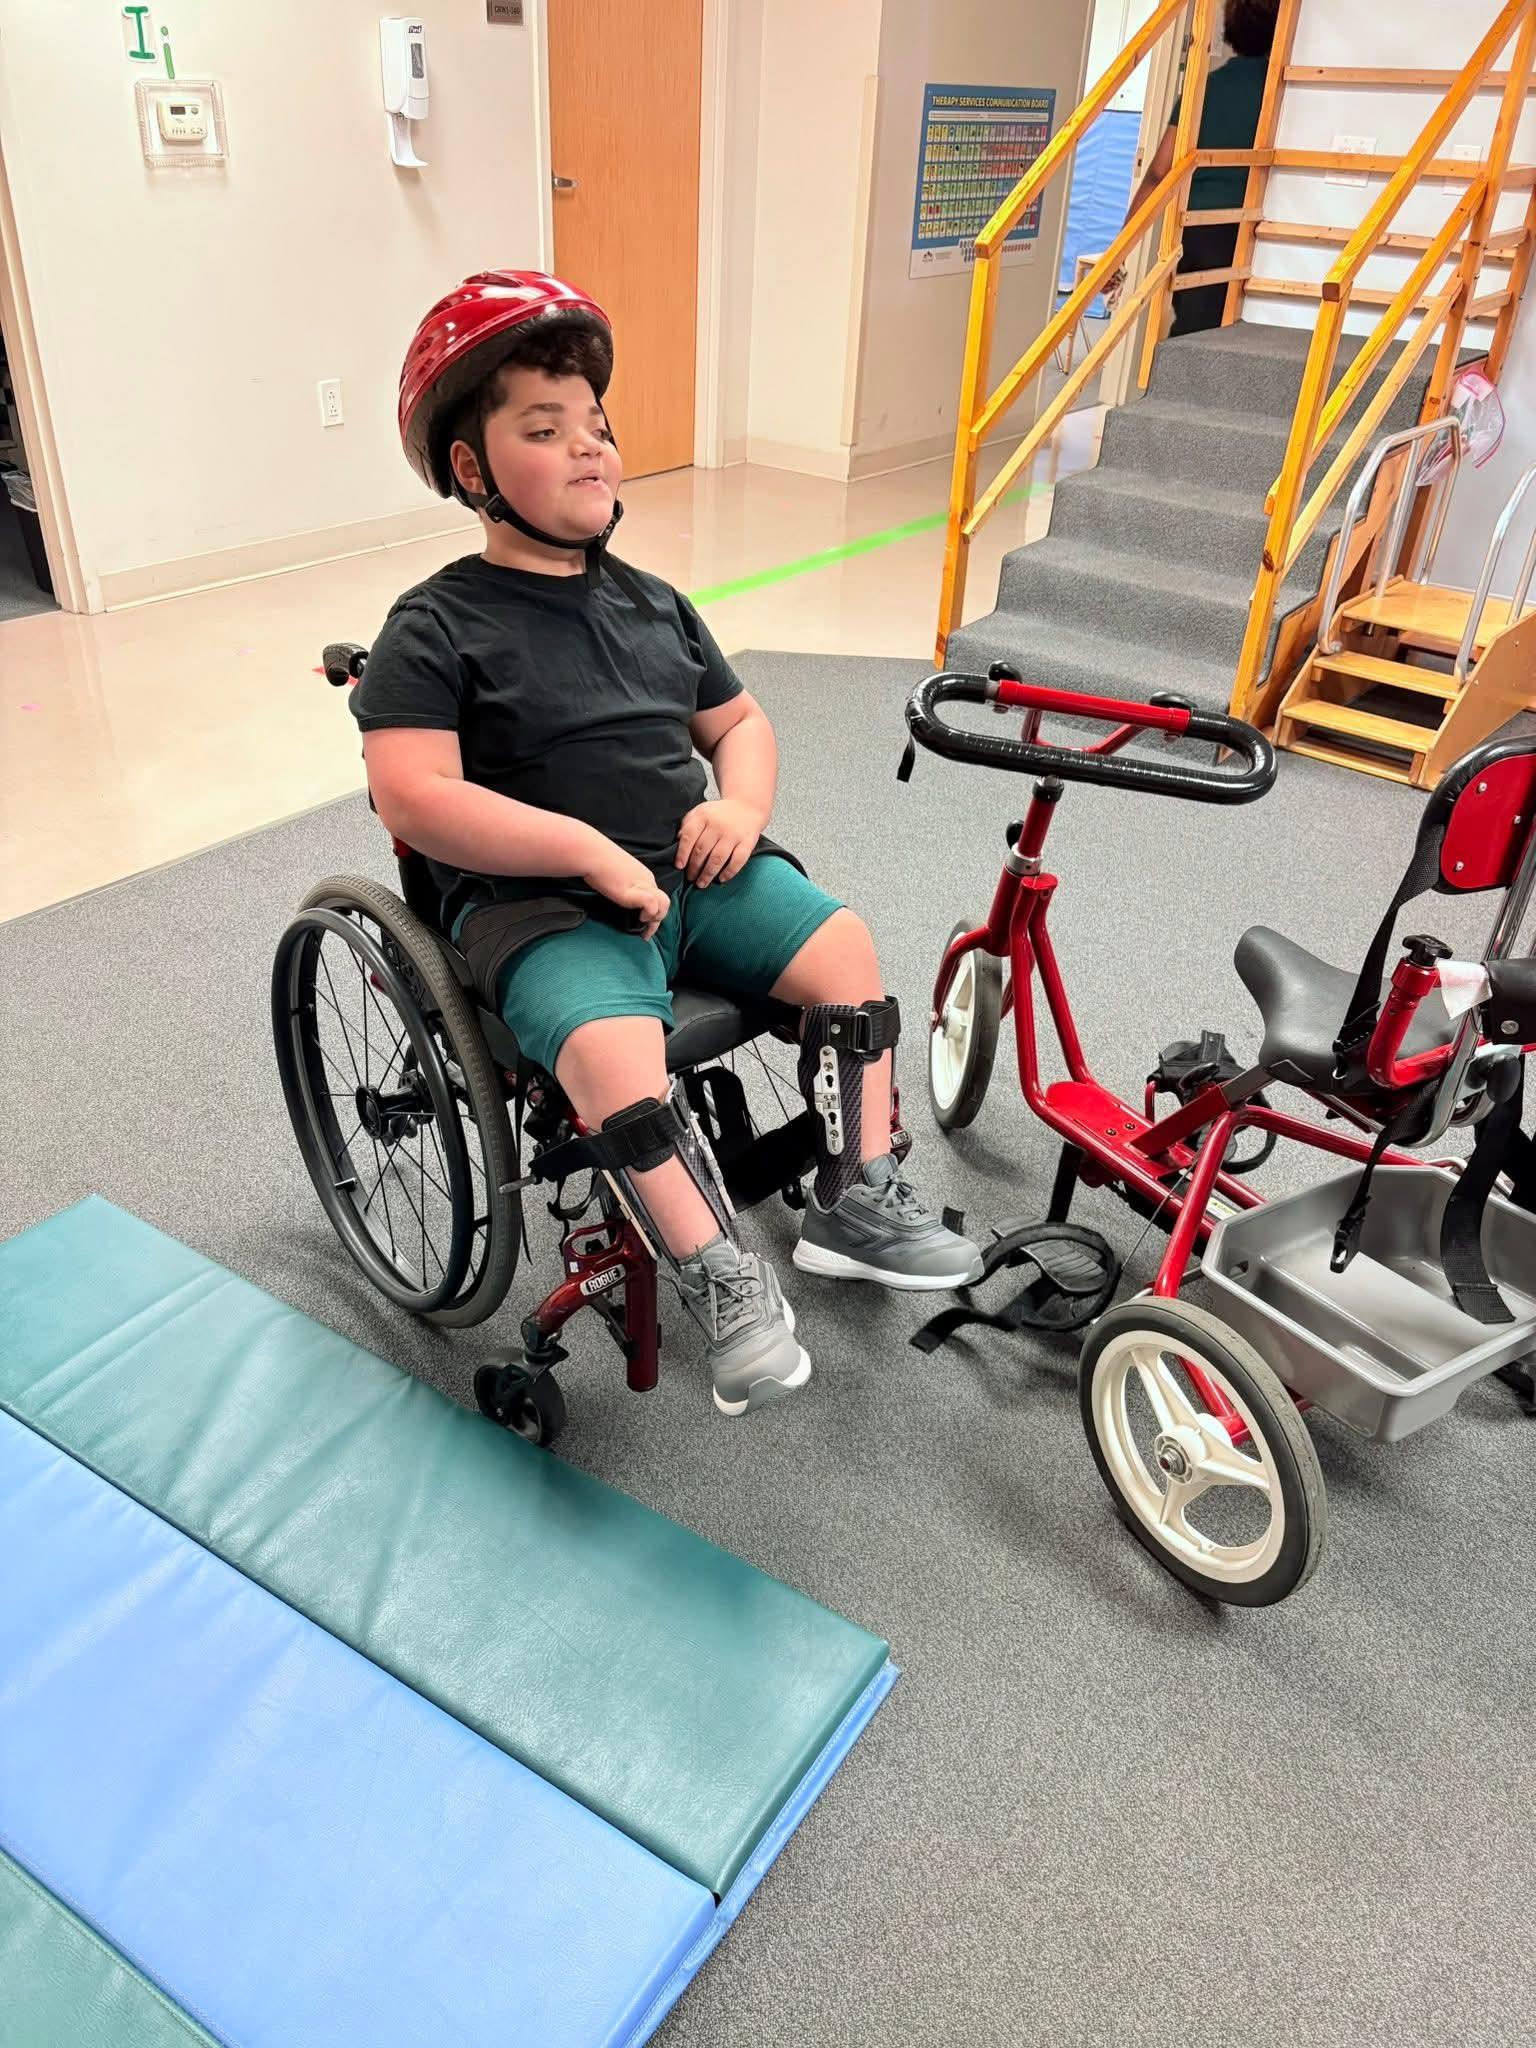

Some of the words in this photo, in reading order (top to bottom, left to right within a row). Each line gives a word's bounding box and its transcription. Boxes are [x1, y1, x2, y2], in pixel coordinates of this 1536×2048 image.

[932, 95, 959, 106] THERAPY
[959, 96, 985, 107] SERVICES
[985, 97, 1030, 108] COMMUNICATION
[1030, 98, 1048, 109] BOARD
[587, 1268, 619, 1291] ROGUE
